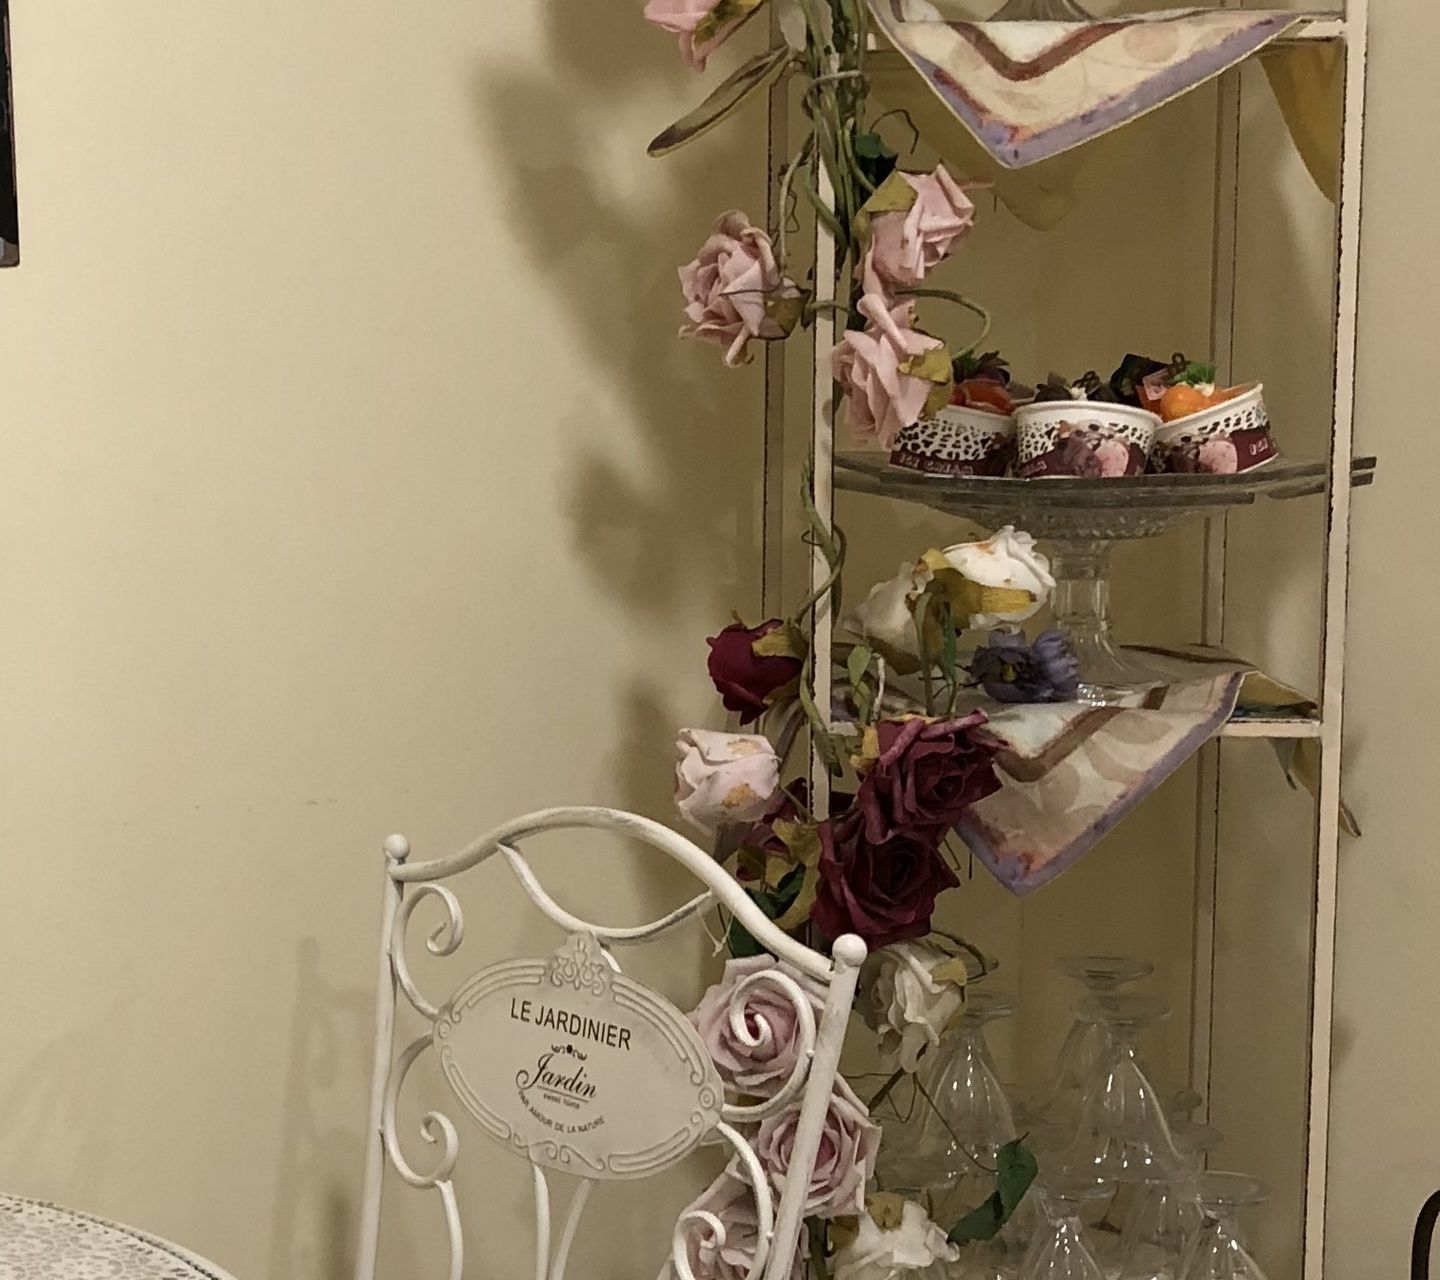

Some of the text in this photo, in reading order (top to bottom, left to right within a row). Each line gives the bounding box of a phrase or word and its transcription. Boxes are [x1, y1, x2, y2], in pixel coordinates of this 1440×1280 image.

[511, 997, 632, 1051] LE JARDINIER
[515, 1053, 597, 1098] Jardin
